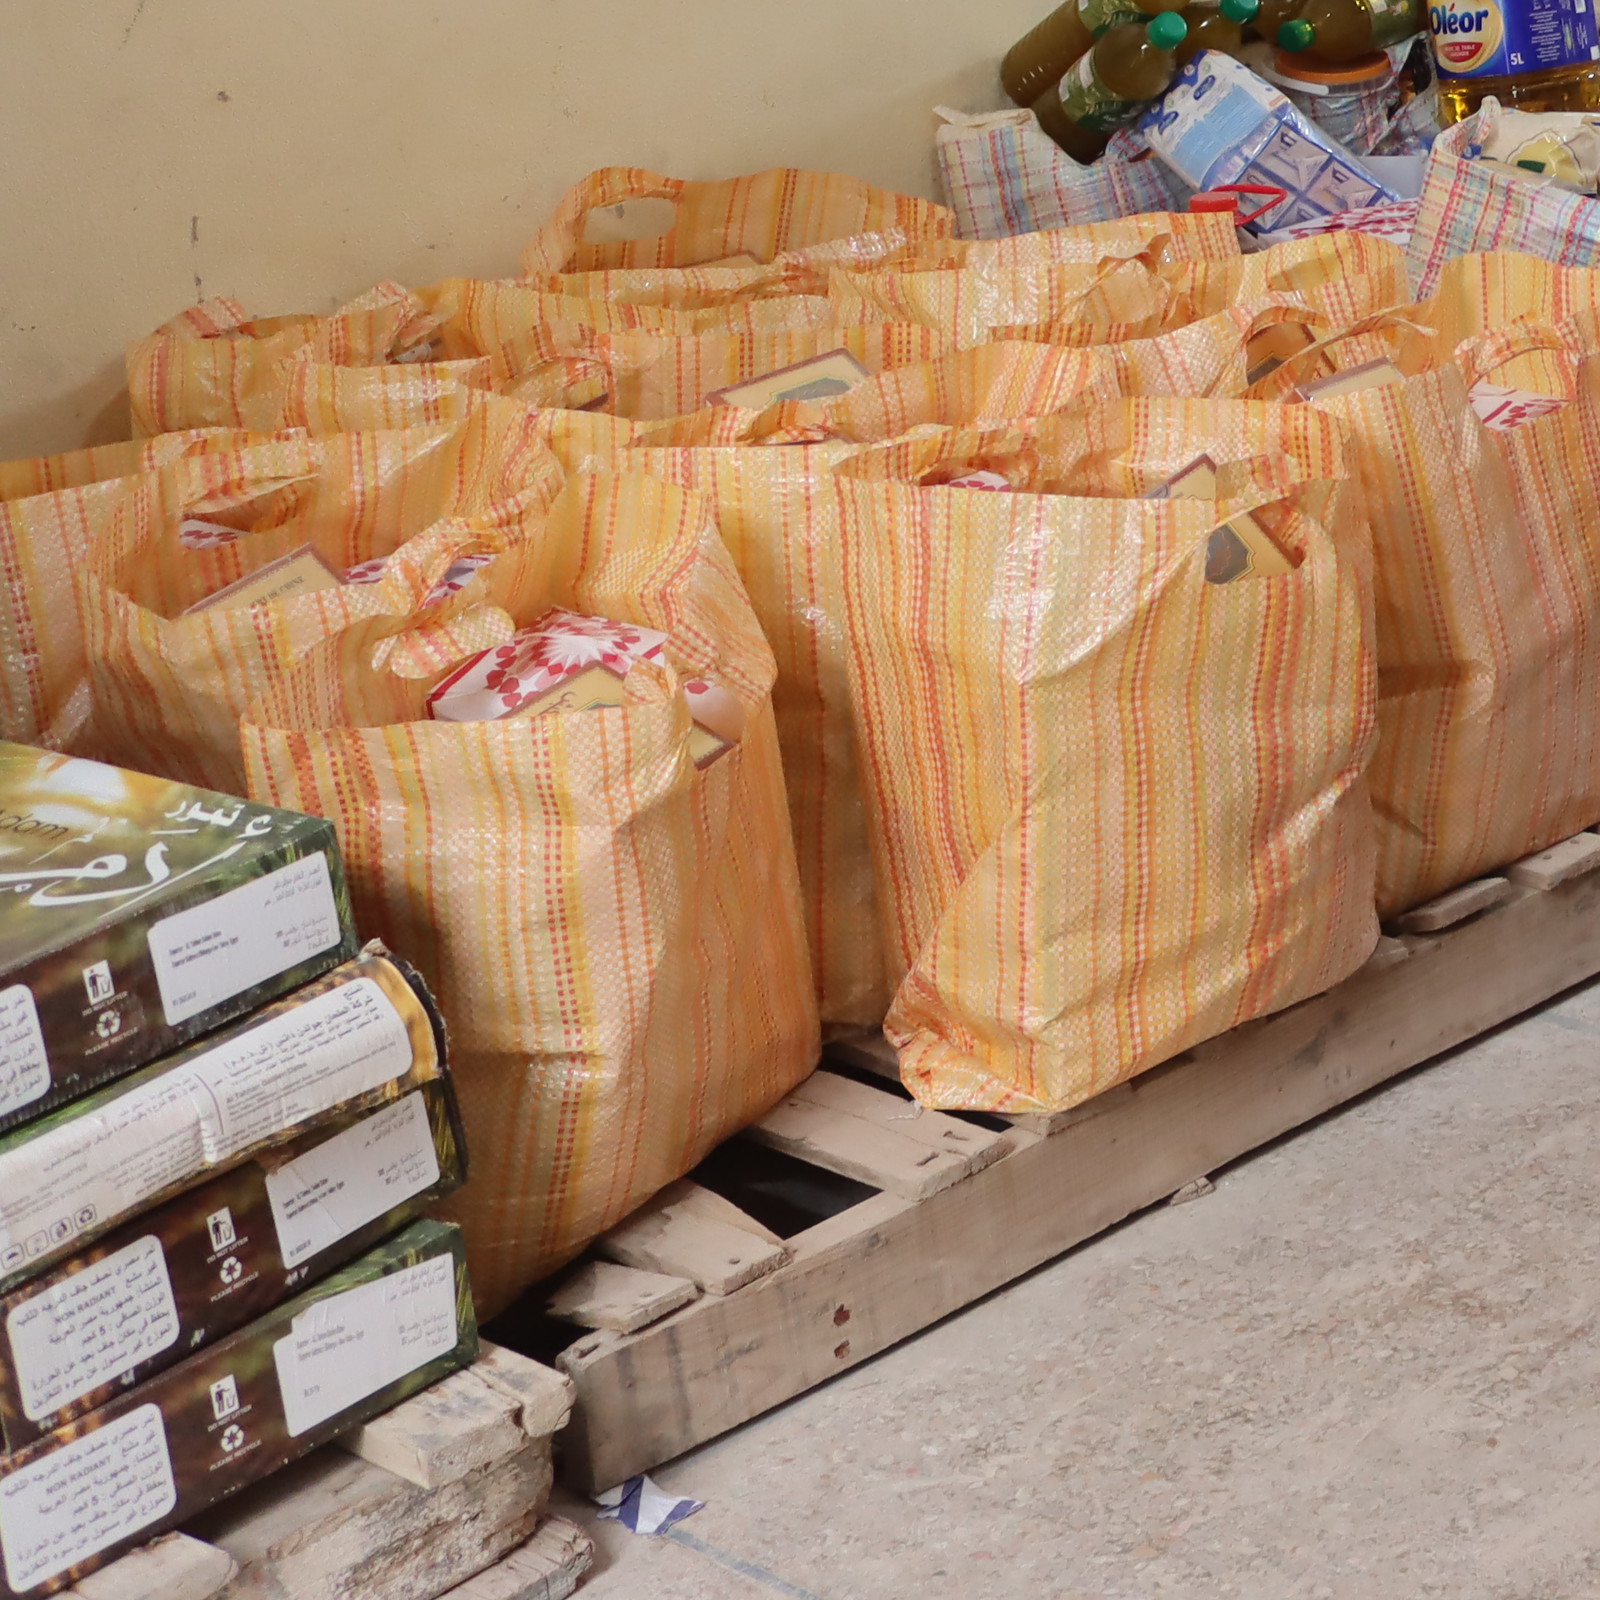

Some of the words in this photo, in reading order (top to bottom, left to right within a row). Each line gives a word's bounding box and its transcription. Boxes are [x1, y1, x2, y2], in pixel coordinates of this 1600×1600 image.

[1430, 3, 1489, 35] Oléor
[1509, 52, 1525, 66] 5L
[54, 1310, 76, 1325] NON
[77, 1285, 116, 1312] RADIANT
[99, 1325, 106, 1336] 5
[46, 1480, 68, 1495] NON
[70, 1455, 111, 1482] RADIANT
[91, 1495, 99, 1506] 5
